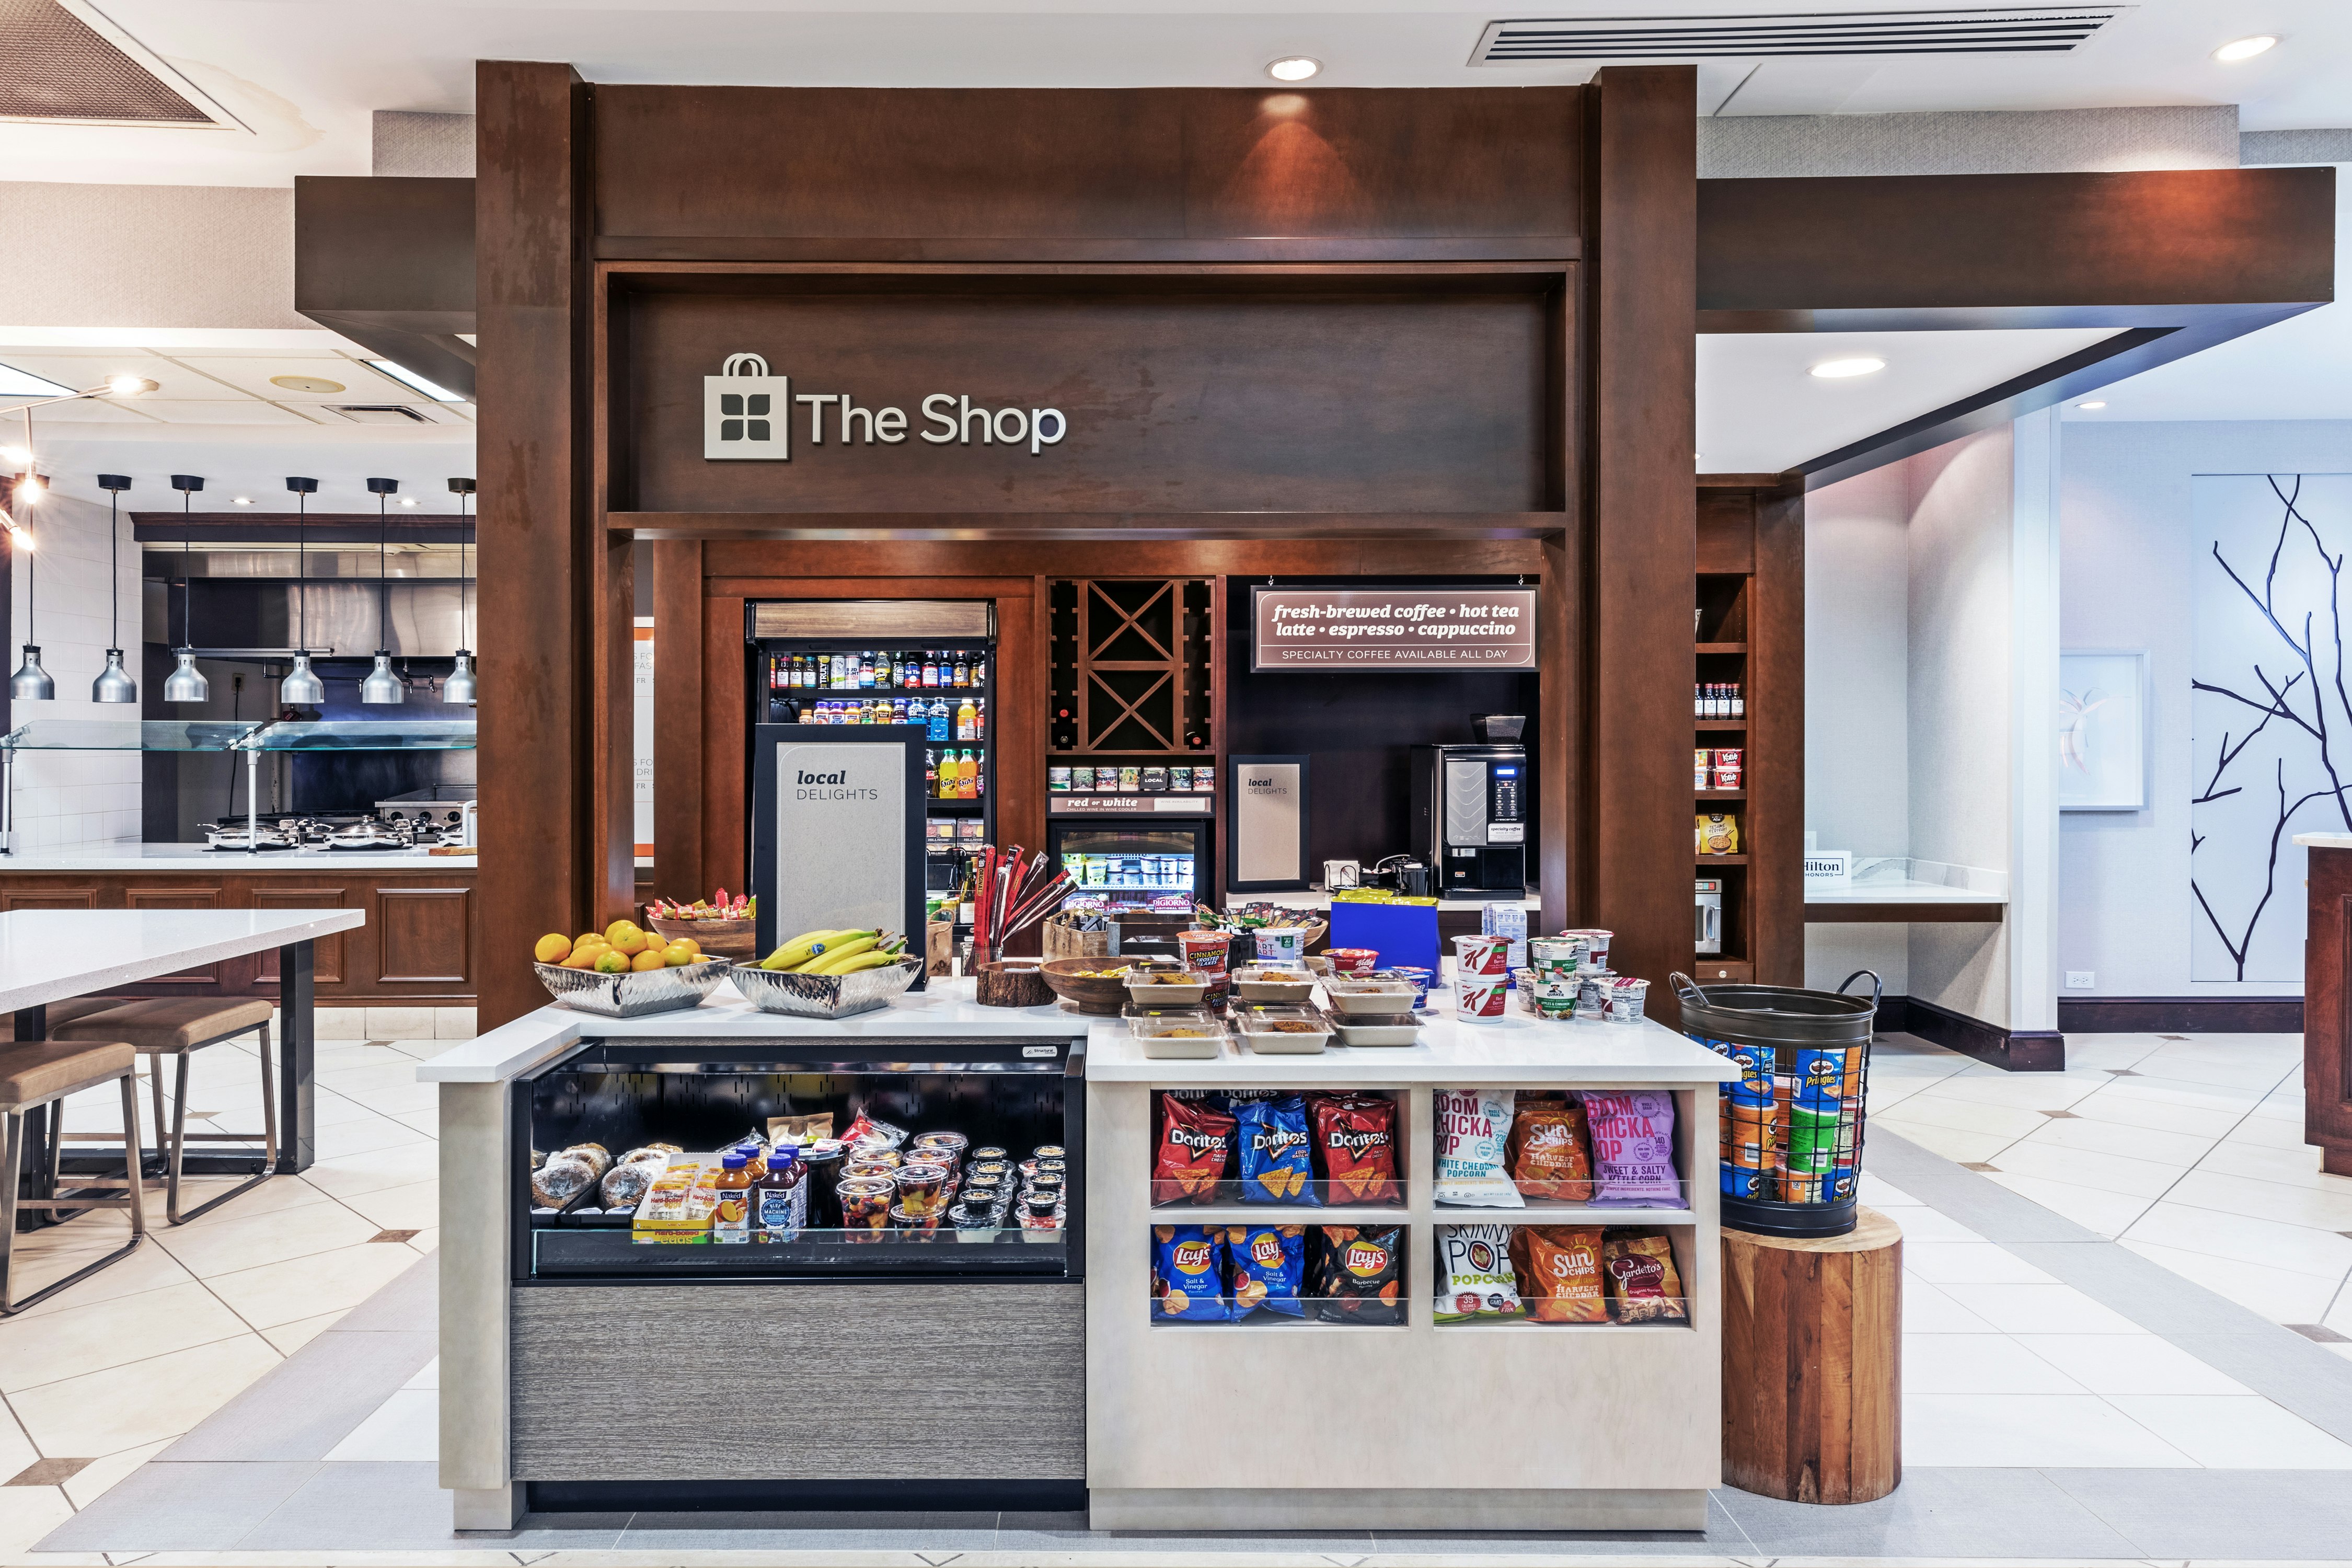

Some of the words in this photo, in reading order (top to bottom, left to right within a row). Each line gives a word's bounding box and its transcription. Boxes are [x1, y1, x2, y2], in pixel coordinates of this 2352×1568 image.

[796, 395, 908, 444] The
[920, 394, 1067, 455] Shop
[1272, 604, 1390, 621] fresh-brewed
[1394, 604, 1446, 621] coffee
[1459, 604, 1489, 618] hot
[1492, 606, 1519, 618] tea
[1276, 622, 1315, 636] latte
[1329, 625, 1404, 639] espresso
[1418, 621, 1515, 638] cappuccino
[1282, 650, 1343, 660] SPECIALTY
[1347, 650, 1390, 659] COFFEE
[1395, 650, 1456, 659] AVAILABLE
[1460, 650, 1481, 659] ALL
[1485, 650, 1508, 659] DAY
[797, 770, 846, 785] local
[797, 789, 878, 800] DELIGHTS
[1068, 798, 1089, 806] red
[1103, 798, 1138, 806] white
[1804, 862, 1839, 871] Hilton
[1189, 949, 1225, 959] CINNAMON
[1464, 947, 1489, 970] K
[1463, 988, 1488, 1011] K
[1806, 1076, 1836, 1088] Pringles
[1434, 1094, 1479, 1115] BOOM
[1585, 1096, 1634, 1119] BOOM
[1435, 1114, 1493, 1138] CHICKA
[1588, 1117, 1655, 1138] CHICKA
[1172, 1129, 1227, 1148] Doritos
[1254, 1132, 1307, 1150] Doritos
[1331, 1132, 1385, 1147] Doritos
[1529, 1124, 1573, 1145] Sun
[1545, 1136, 1573, 1146] CHIPS
[1530, 1160, 1573, 1168] CHEDDAR
[1531, 1153, 1574, 1162] HARVEST
[1603, 1165, 1628, 1174] SWEET
[1631, 1166, 1639, 1174] &
[1641, 1166, 1666, 1174] SALTY
[1608, 1174, 1638, 1184] KETTLE
[1639, 1175, 1661, 1184] CORN
[1177, 1247, 1210, 1266] Lay's
[1348, 1249, 1385, 1269] Lay's
[1553, 1253, 1595, 1277] Sun
[1569, 1266, 1596, 1276] CHIPS
[1452, 1272, 1516, 1286] POPCORN
[1610, 1259, 1662, 1291] Gardetto's
[1557, 1285, 1599, 1293] HARVEST
[1463, 1295, 1473, 1304] 39
